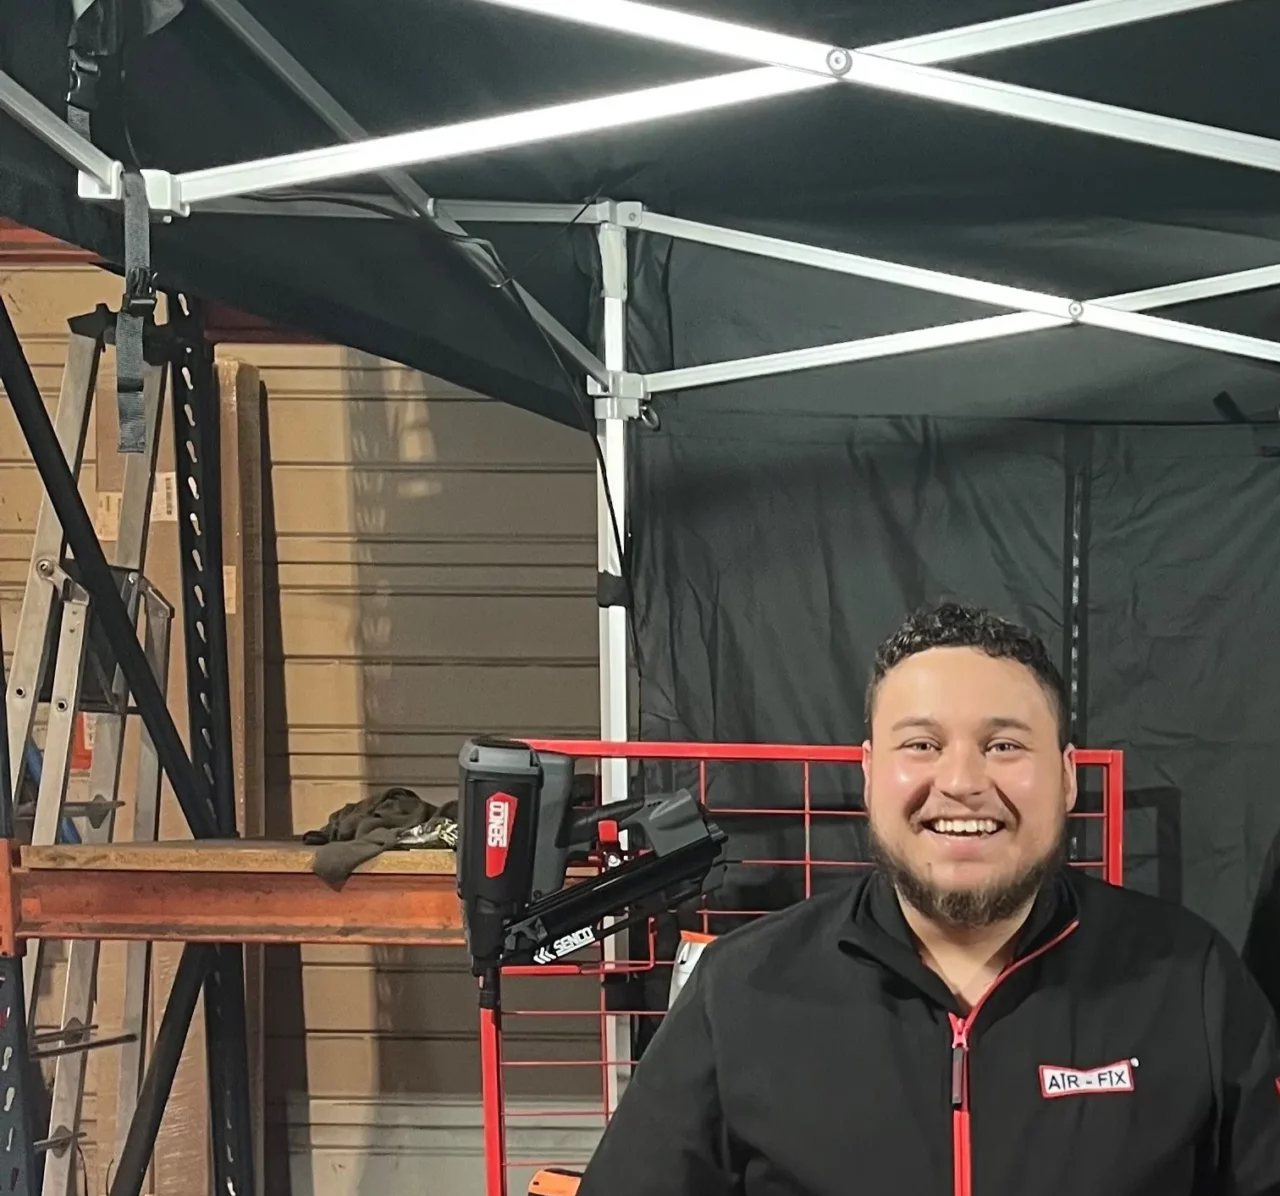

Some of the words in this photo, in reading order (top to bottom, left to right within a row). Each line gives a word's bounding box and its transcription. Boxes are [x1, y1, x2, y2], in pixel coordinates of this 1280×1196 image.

[488, 801, 506, 848] SENCO
[553, 926, 593, 952] SENCO
[1048, 1072, 1080, 1090] AIR
[1097, 1070, 1127, 1087] FIX
